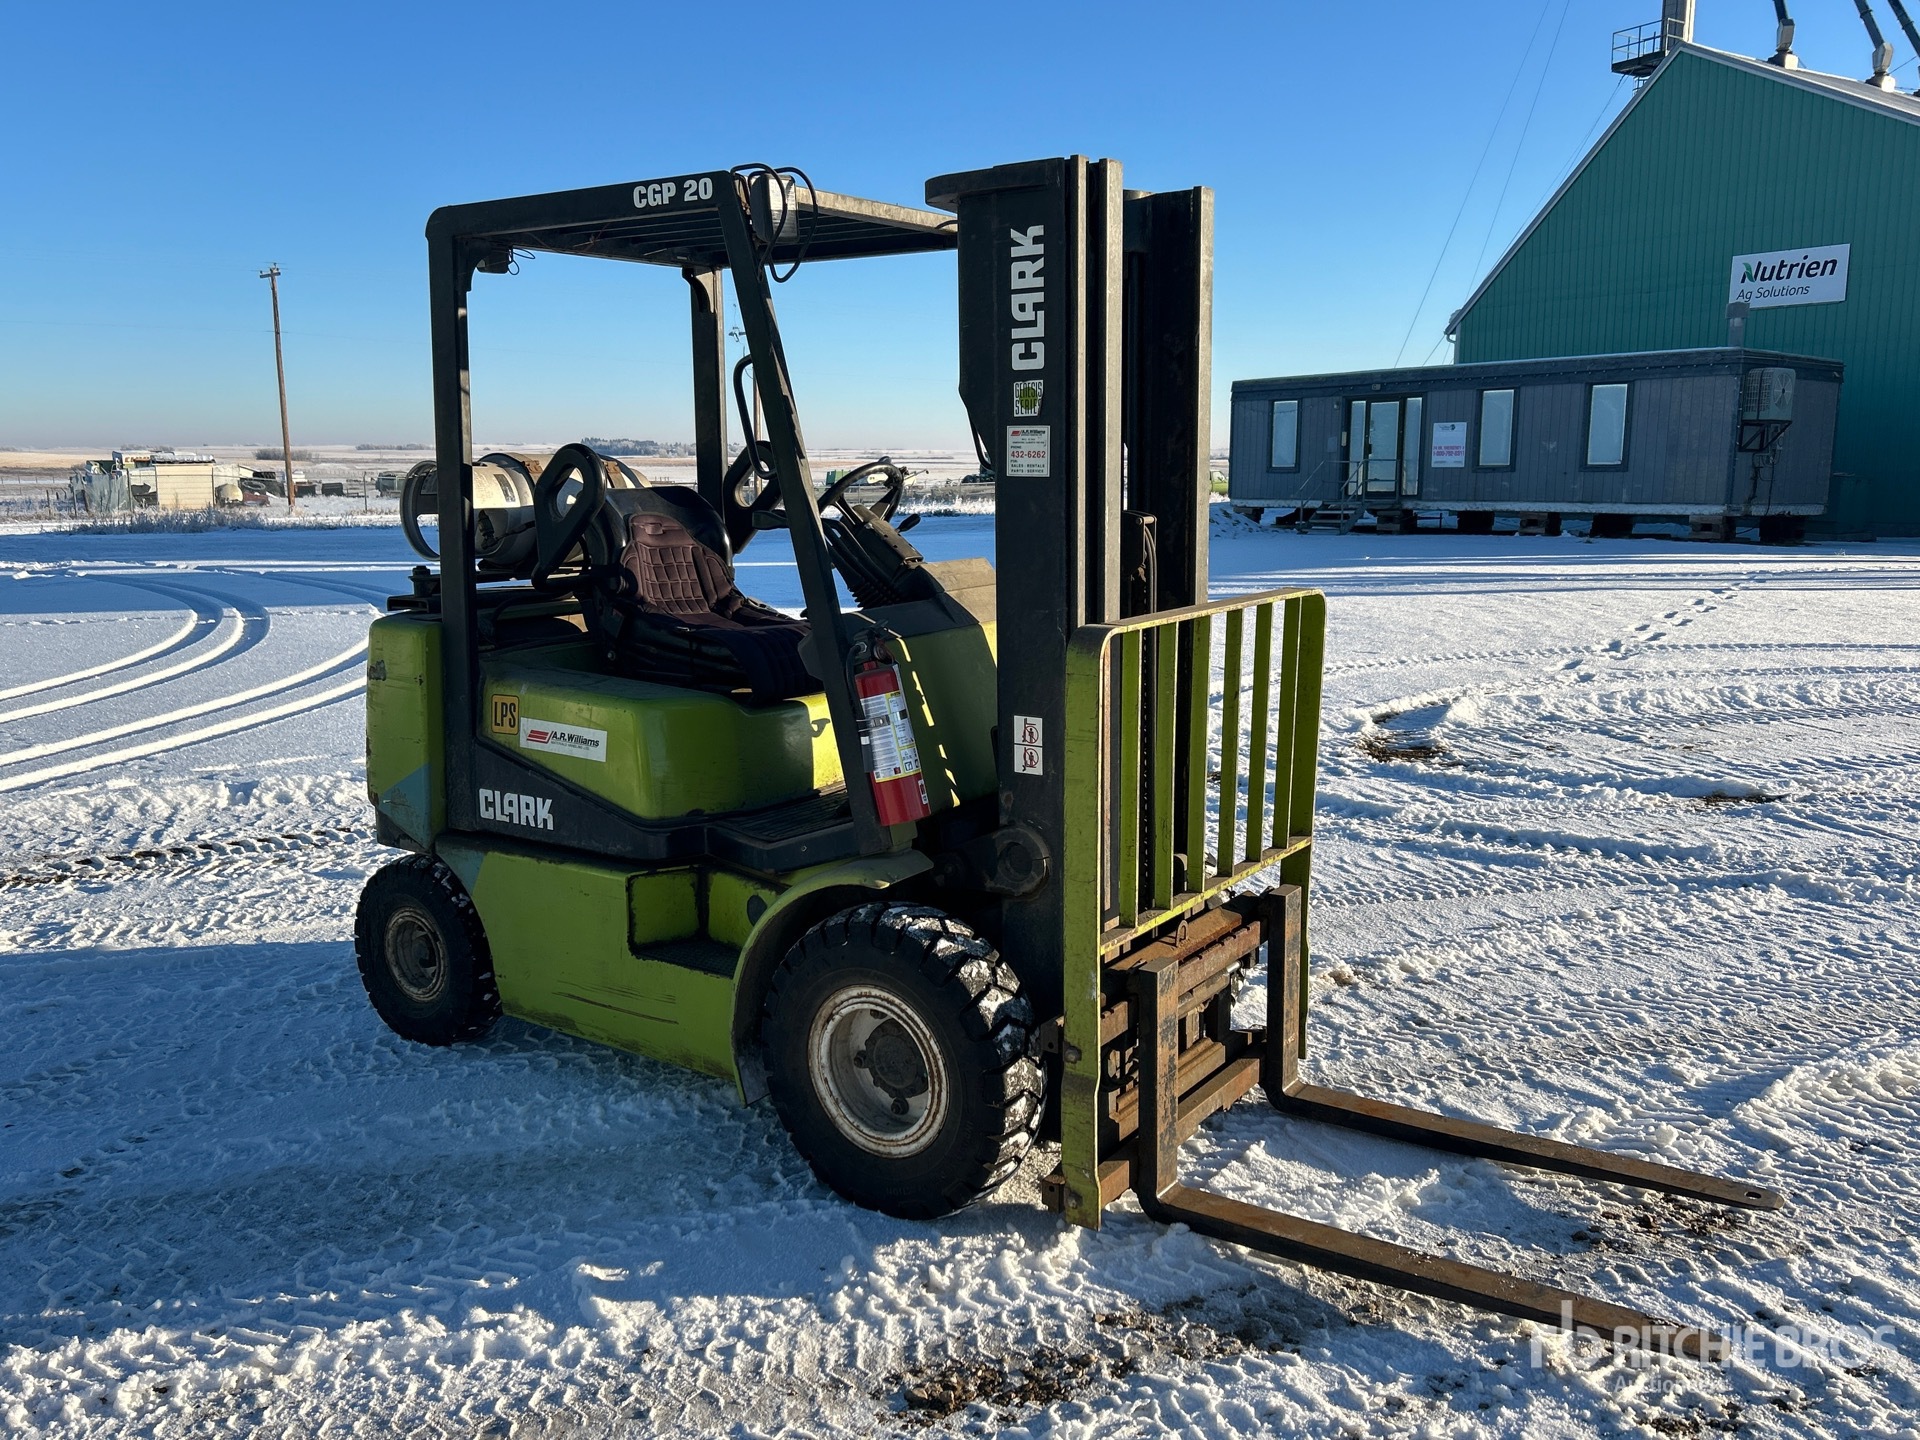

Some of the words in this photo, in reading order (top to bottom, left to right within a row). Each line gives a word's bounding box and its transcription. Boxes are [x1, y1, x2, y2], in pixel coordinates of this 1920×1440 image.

[633, 182, 677, 208] CGP
[683, 177, 713, 201] 20
[1740, 254, 1838, 284] Nutrien
[1010, 224, 1044, 371] CLARK
[1736, 289, 1753, 303] Ag
[1755, 285, 1810, 299] Solutions
[1010, 450, 1046, 459] 432-6262
[494, 701, 517, 728] LPS
[478, 788, 554, 831] CLARK
